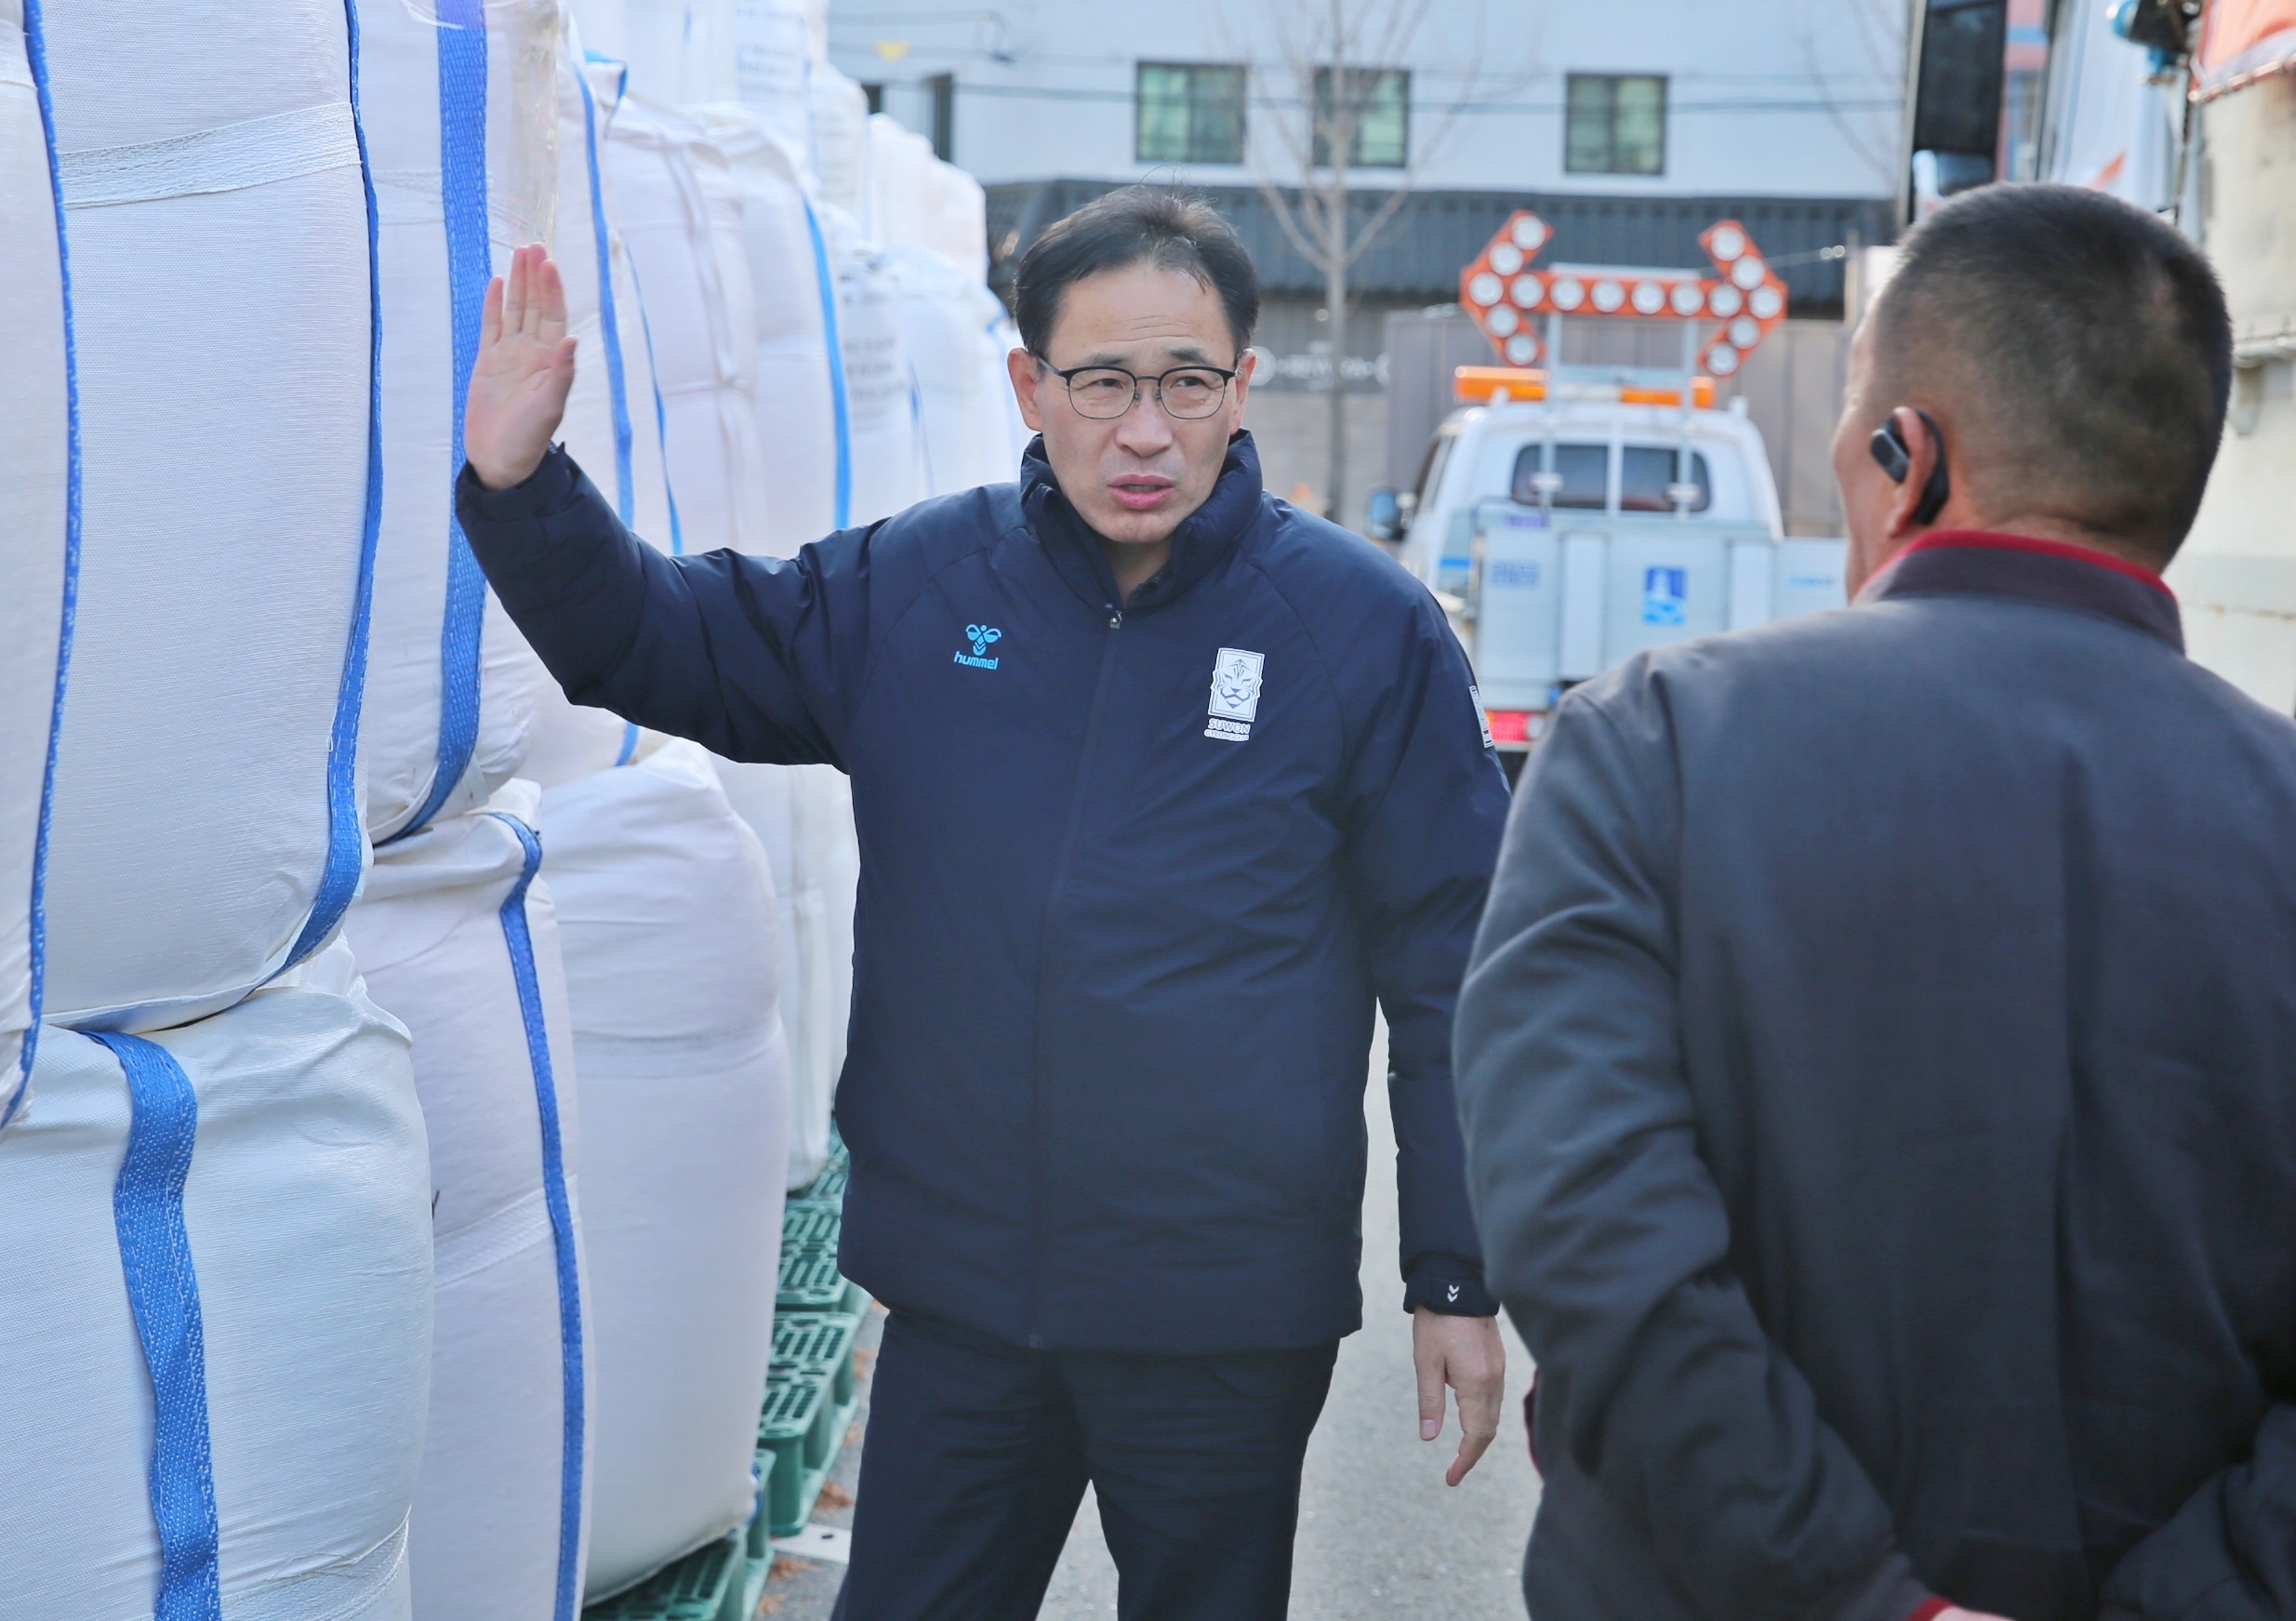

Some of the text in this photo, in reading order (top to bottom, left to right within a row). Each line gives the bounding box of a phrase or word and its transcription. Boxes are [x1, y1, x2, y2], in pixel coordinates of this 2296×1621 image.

[954, 651, 999, 670] hummel
[1209, 718, 1250, 734] SUWON
[1205, 729, 1241, 740] GYEONGGI
